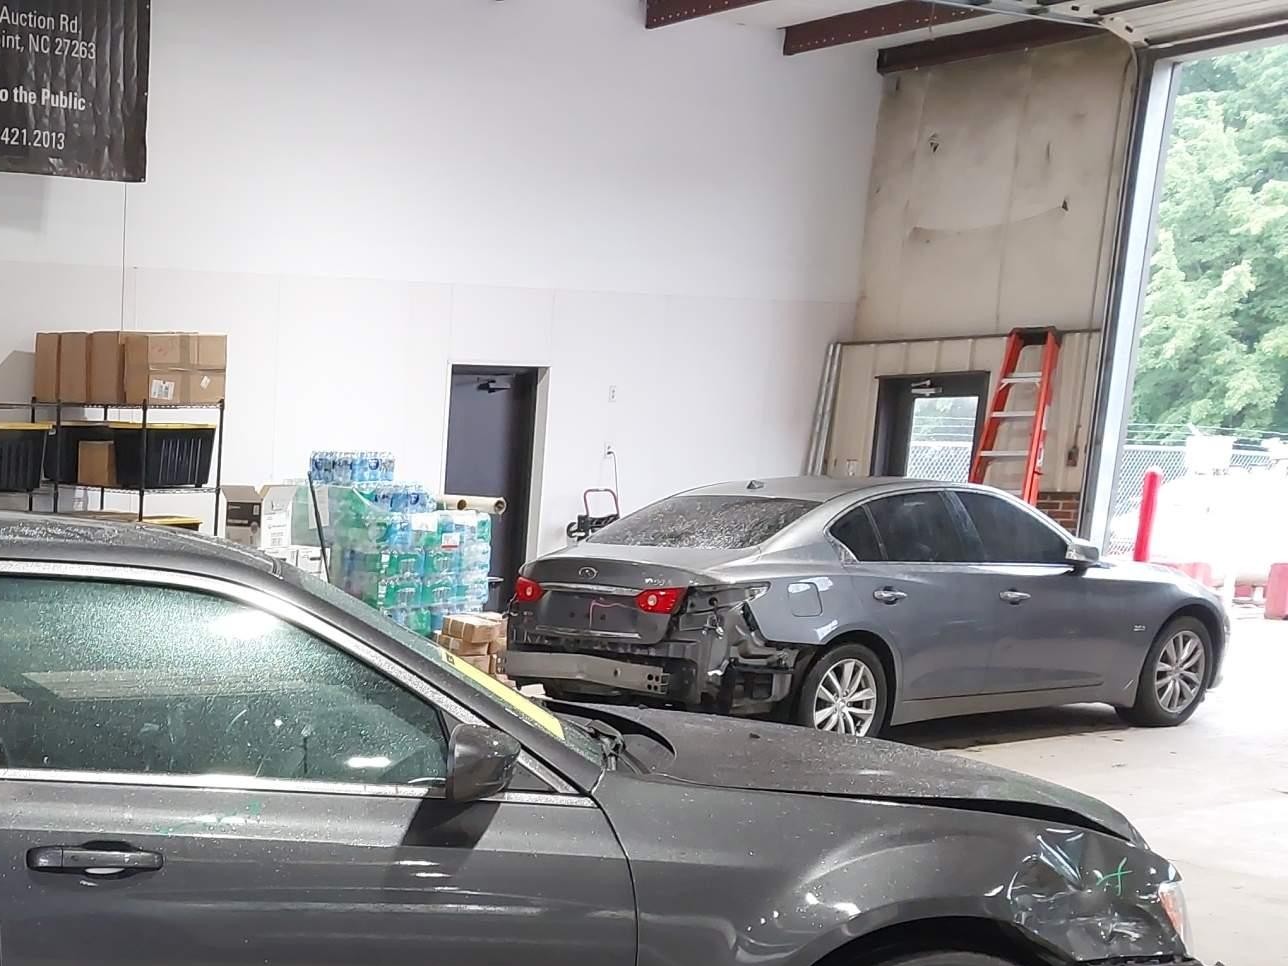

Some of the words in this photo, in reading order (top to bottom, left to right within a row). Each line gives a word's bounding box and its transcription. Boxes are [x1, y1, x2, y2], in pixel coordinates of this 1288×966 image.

[0, 6, 54, 30] Auction
[29, 33, 50, 54] NC
[55, 38, 96, 60] 27263
[13, 85, 37, 104] the
[41, 88, 86, 111] Public
